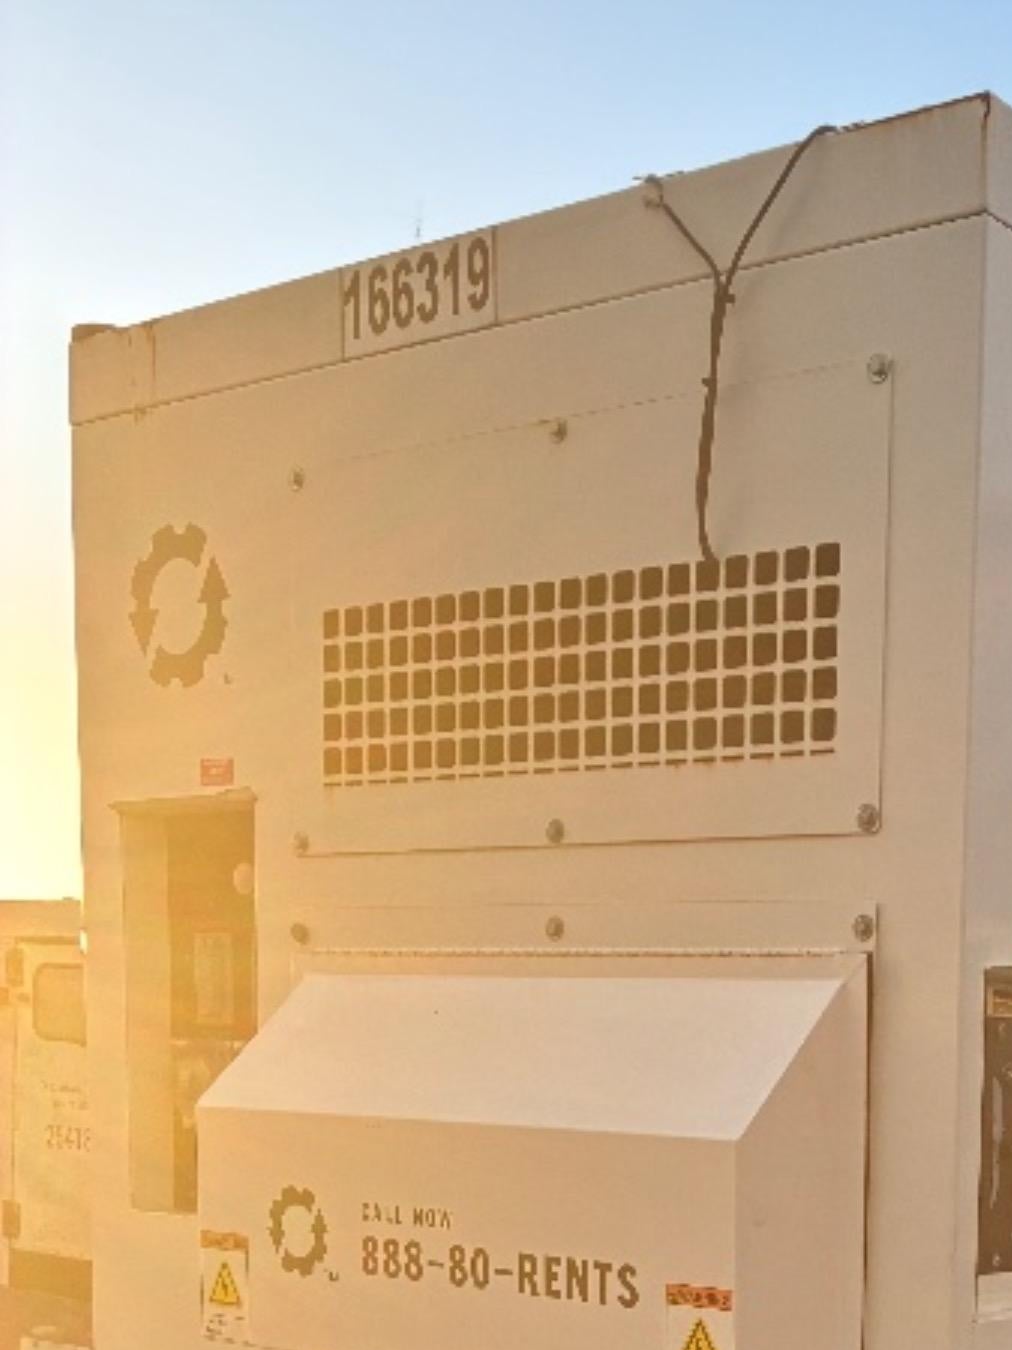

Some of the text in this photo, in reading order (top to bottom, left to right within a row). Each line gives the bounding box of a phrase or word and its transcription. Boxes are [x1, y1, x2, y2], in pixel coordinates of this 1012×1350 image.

[343, 236, 490, 340] 166319
[362, 1202, 402, 1225] CALL
[362, 1235, 640, 1309] 888-80-RENTS
